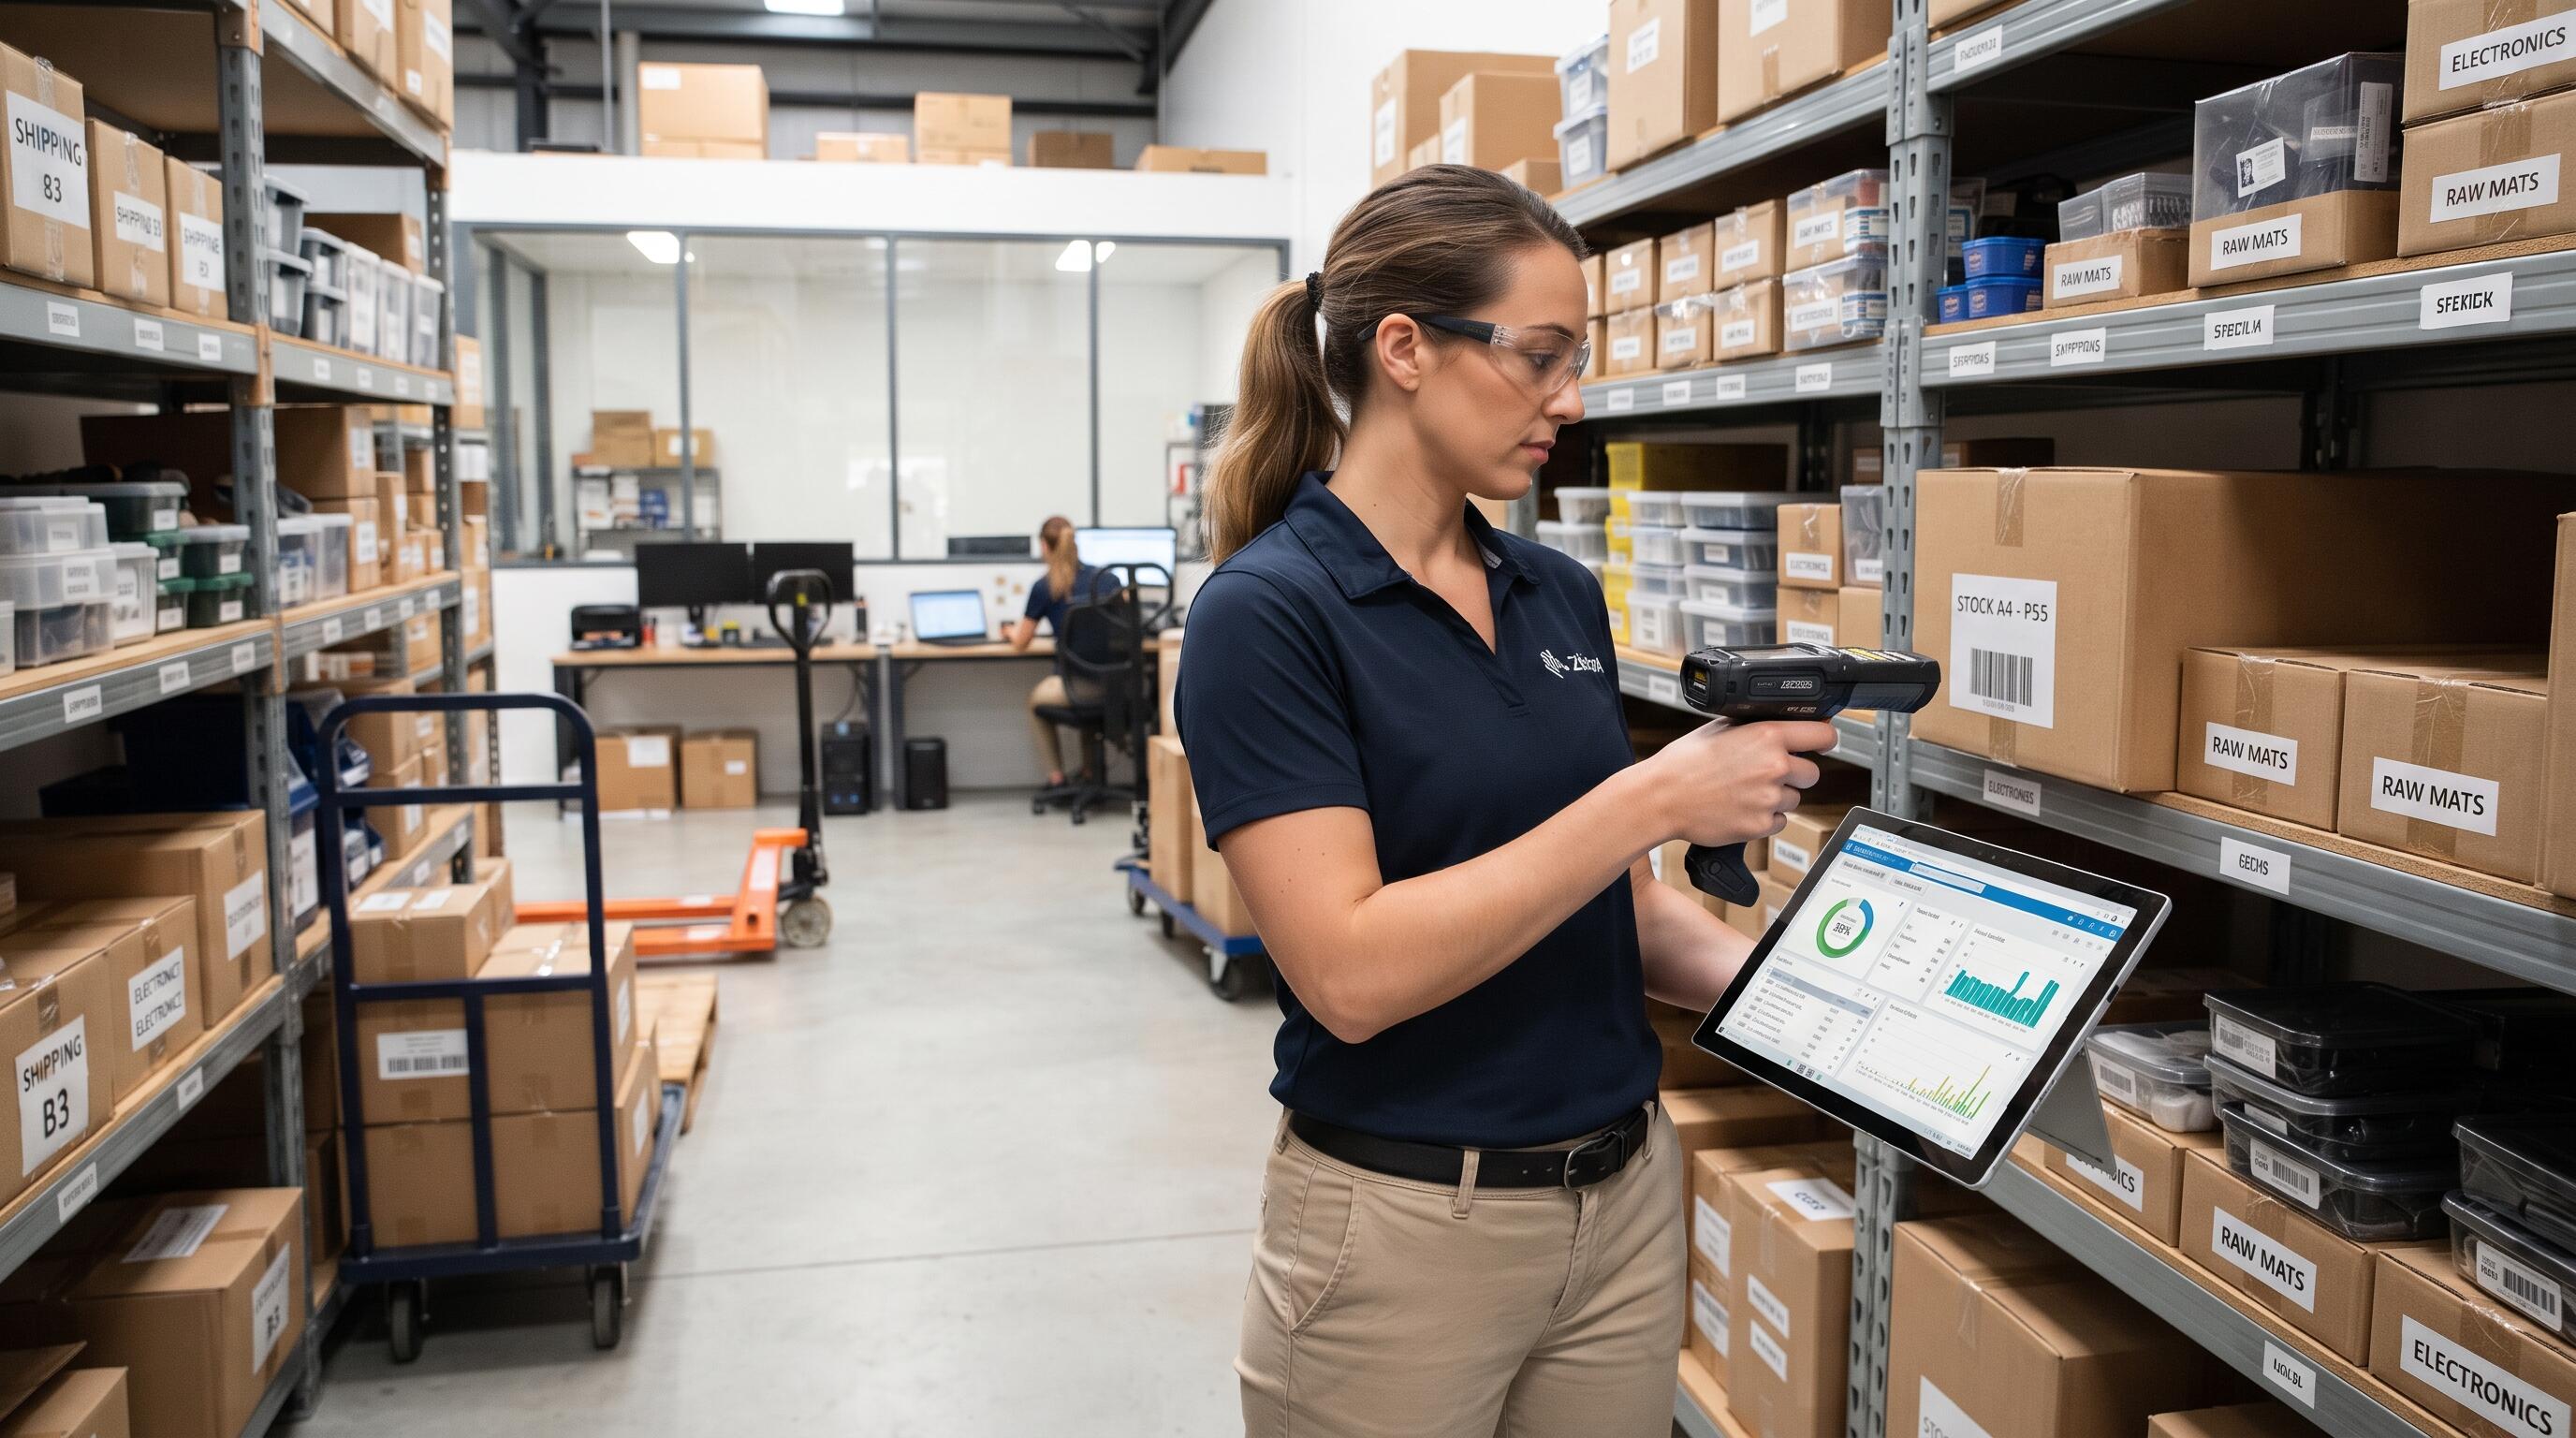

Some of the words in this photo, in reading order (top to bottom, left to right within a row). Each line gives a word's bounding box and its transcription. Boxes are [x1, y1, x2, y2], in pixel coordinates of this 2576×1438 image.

[2452, 26, 2566, 73] ELECTRONICS
[15, 118, 82, 167] SHIPPING
[43, 174, 62, 203] 83
[2446, 182, 2485, 207] RAW
[2489, 171, 2539, 198] MATS
[2222, 236, 2250, 256] RAW
[2252, 228, 2288, 250] MATS
[2060, 271, 2083, 287] RAW
[2084, 266, 2111, 285] MATS
[1957, 594, 1994, 615] STOCK
[1997, 599, 2013, 618] A4
[2024, 602, 2048, 623] P55
[2213, 736, 2245, 759] RAW
[2247, 744, 2288, 770] MATS
[2382, 775, 2425, 802] RAW
[2429, 785, 2485, 815] MATS
[23, 1034, 81, 1093] SHIPPING
[43, 1088, 69, 1138] B3
[2221, 1225, 2256, 1262] RAW
[2261, 1249, 2305, 1292] MATS
[2413, 1339, 2553, 1436] ELECTRONICS
[1924, 1416, 1950, 1438] STO
